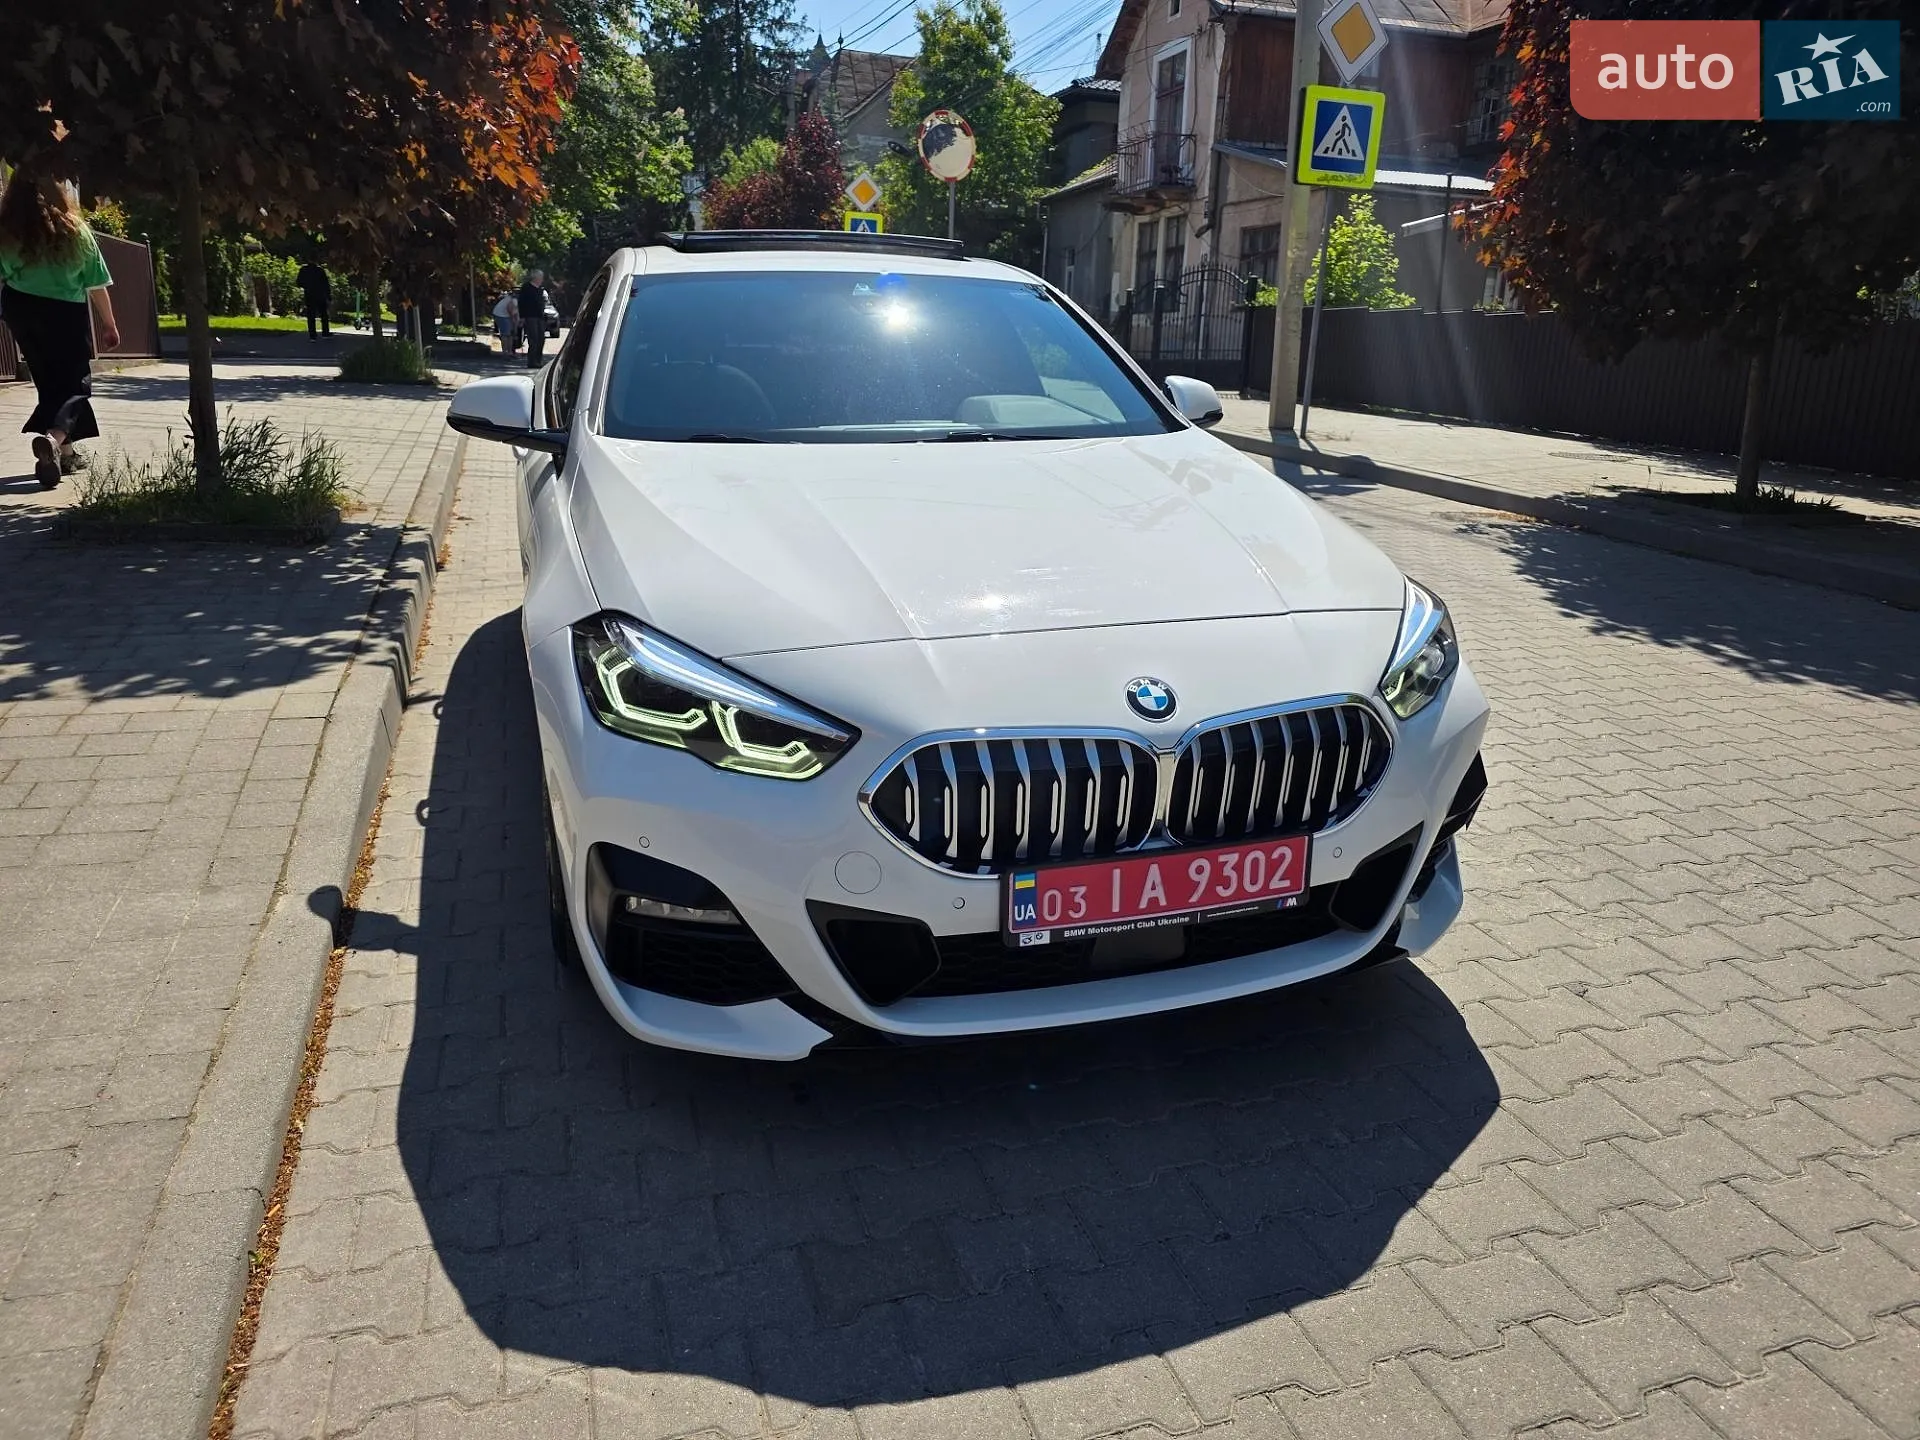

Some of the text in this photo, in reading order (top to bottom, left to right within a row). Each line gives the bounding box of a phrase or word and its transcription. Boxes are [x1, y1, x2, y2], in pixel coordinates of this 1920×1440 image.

[1128, 679, 1168, 692] BMW
[1042, 846, 1292, 921] 03 IA 9302
[1014, 904, 1036, 921] UA
[1087, 923, 1135, 935] Motorsport
[1137, 920, 1156, 928] Club
[1157, 916, 1189, 926] Ukraine
